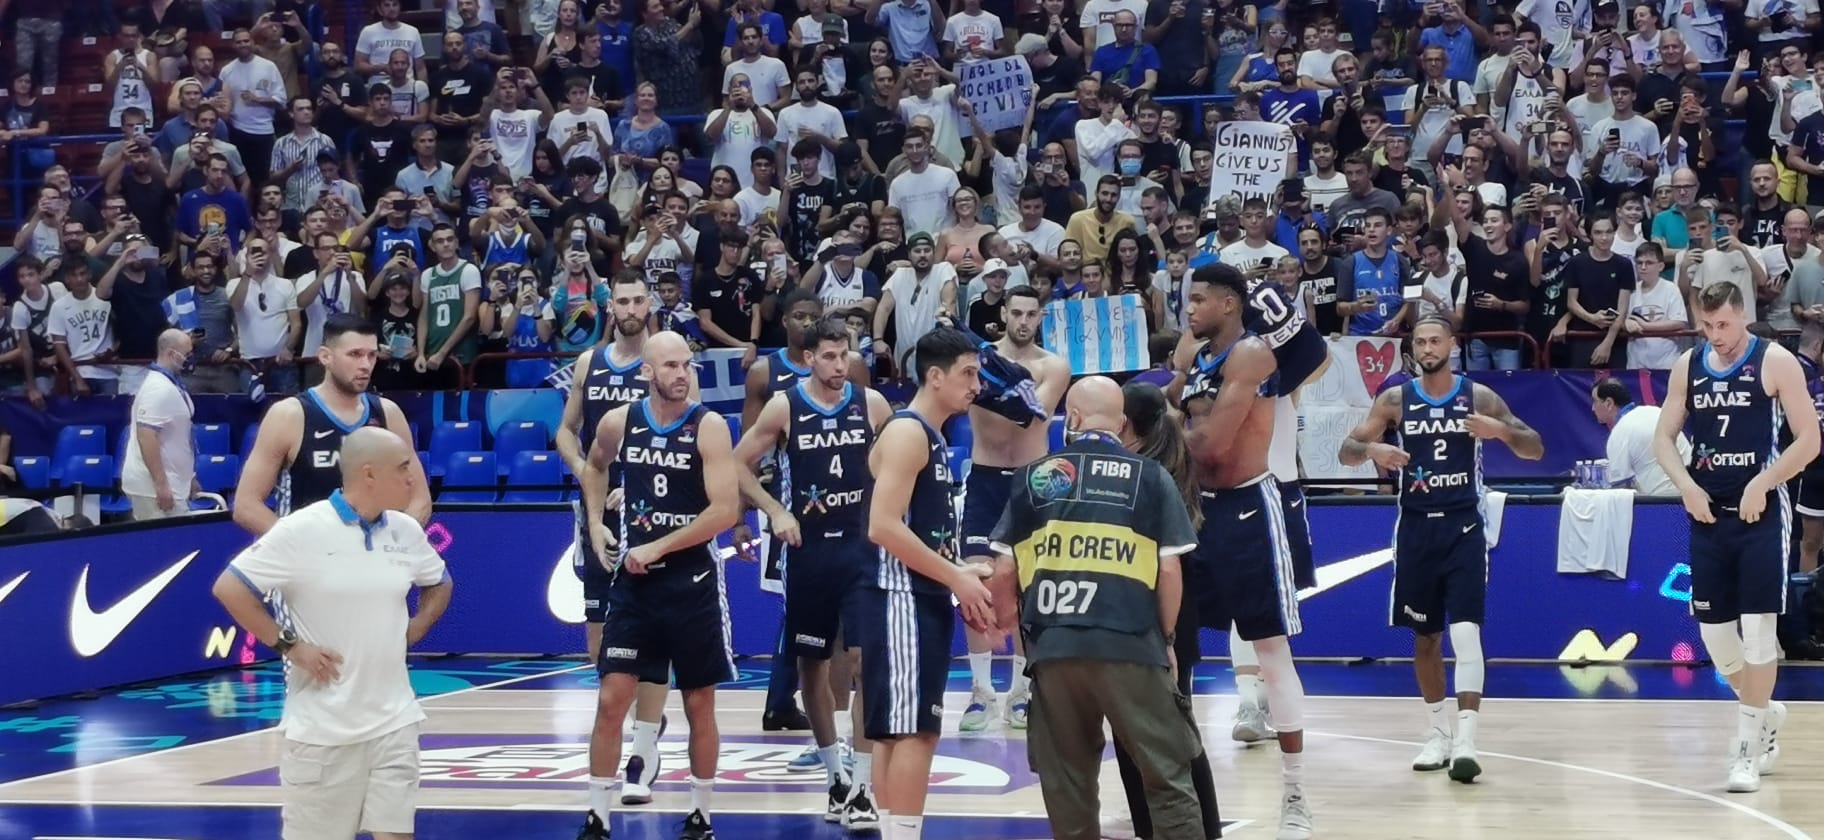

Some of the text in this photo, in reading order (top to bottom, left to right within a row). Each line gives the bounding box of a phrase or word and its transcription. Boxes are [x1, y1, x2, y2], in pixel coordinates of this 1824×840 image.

[122, 84, 138, 99] 34
[1216, 152, 1282, 173] GIVE US
[1232, 173, 1261, 186] THE
[67, 310, 107, 328] BUCKS
[436, 303, 450, 327] 0
[80, 323, 101, 343] 34
[1365, 356, 1385, 372] 34
[1717, 414, 1730, 437] 7
[1433, 438, 1448, 460] 2
[829, 454, 843, 478] 4
[1091, 459, 1132, 479] FIBA
[653, 473, 668, 497] 8
[1069, 534, 1137, 565] CREW
[1037, 579, 1098, 615] 027
